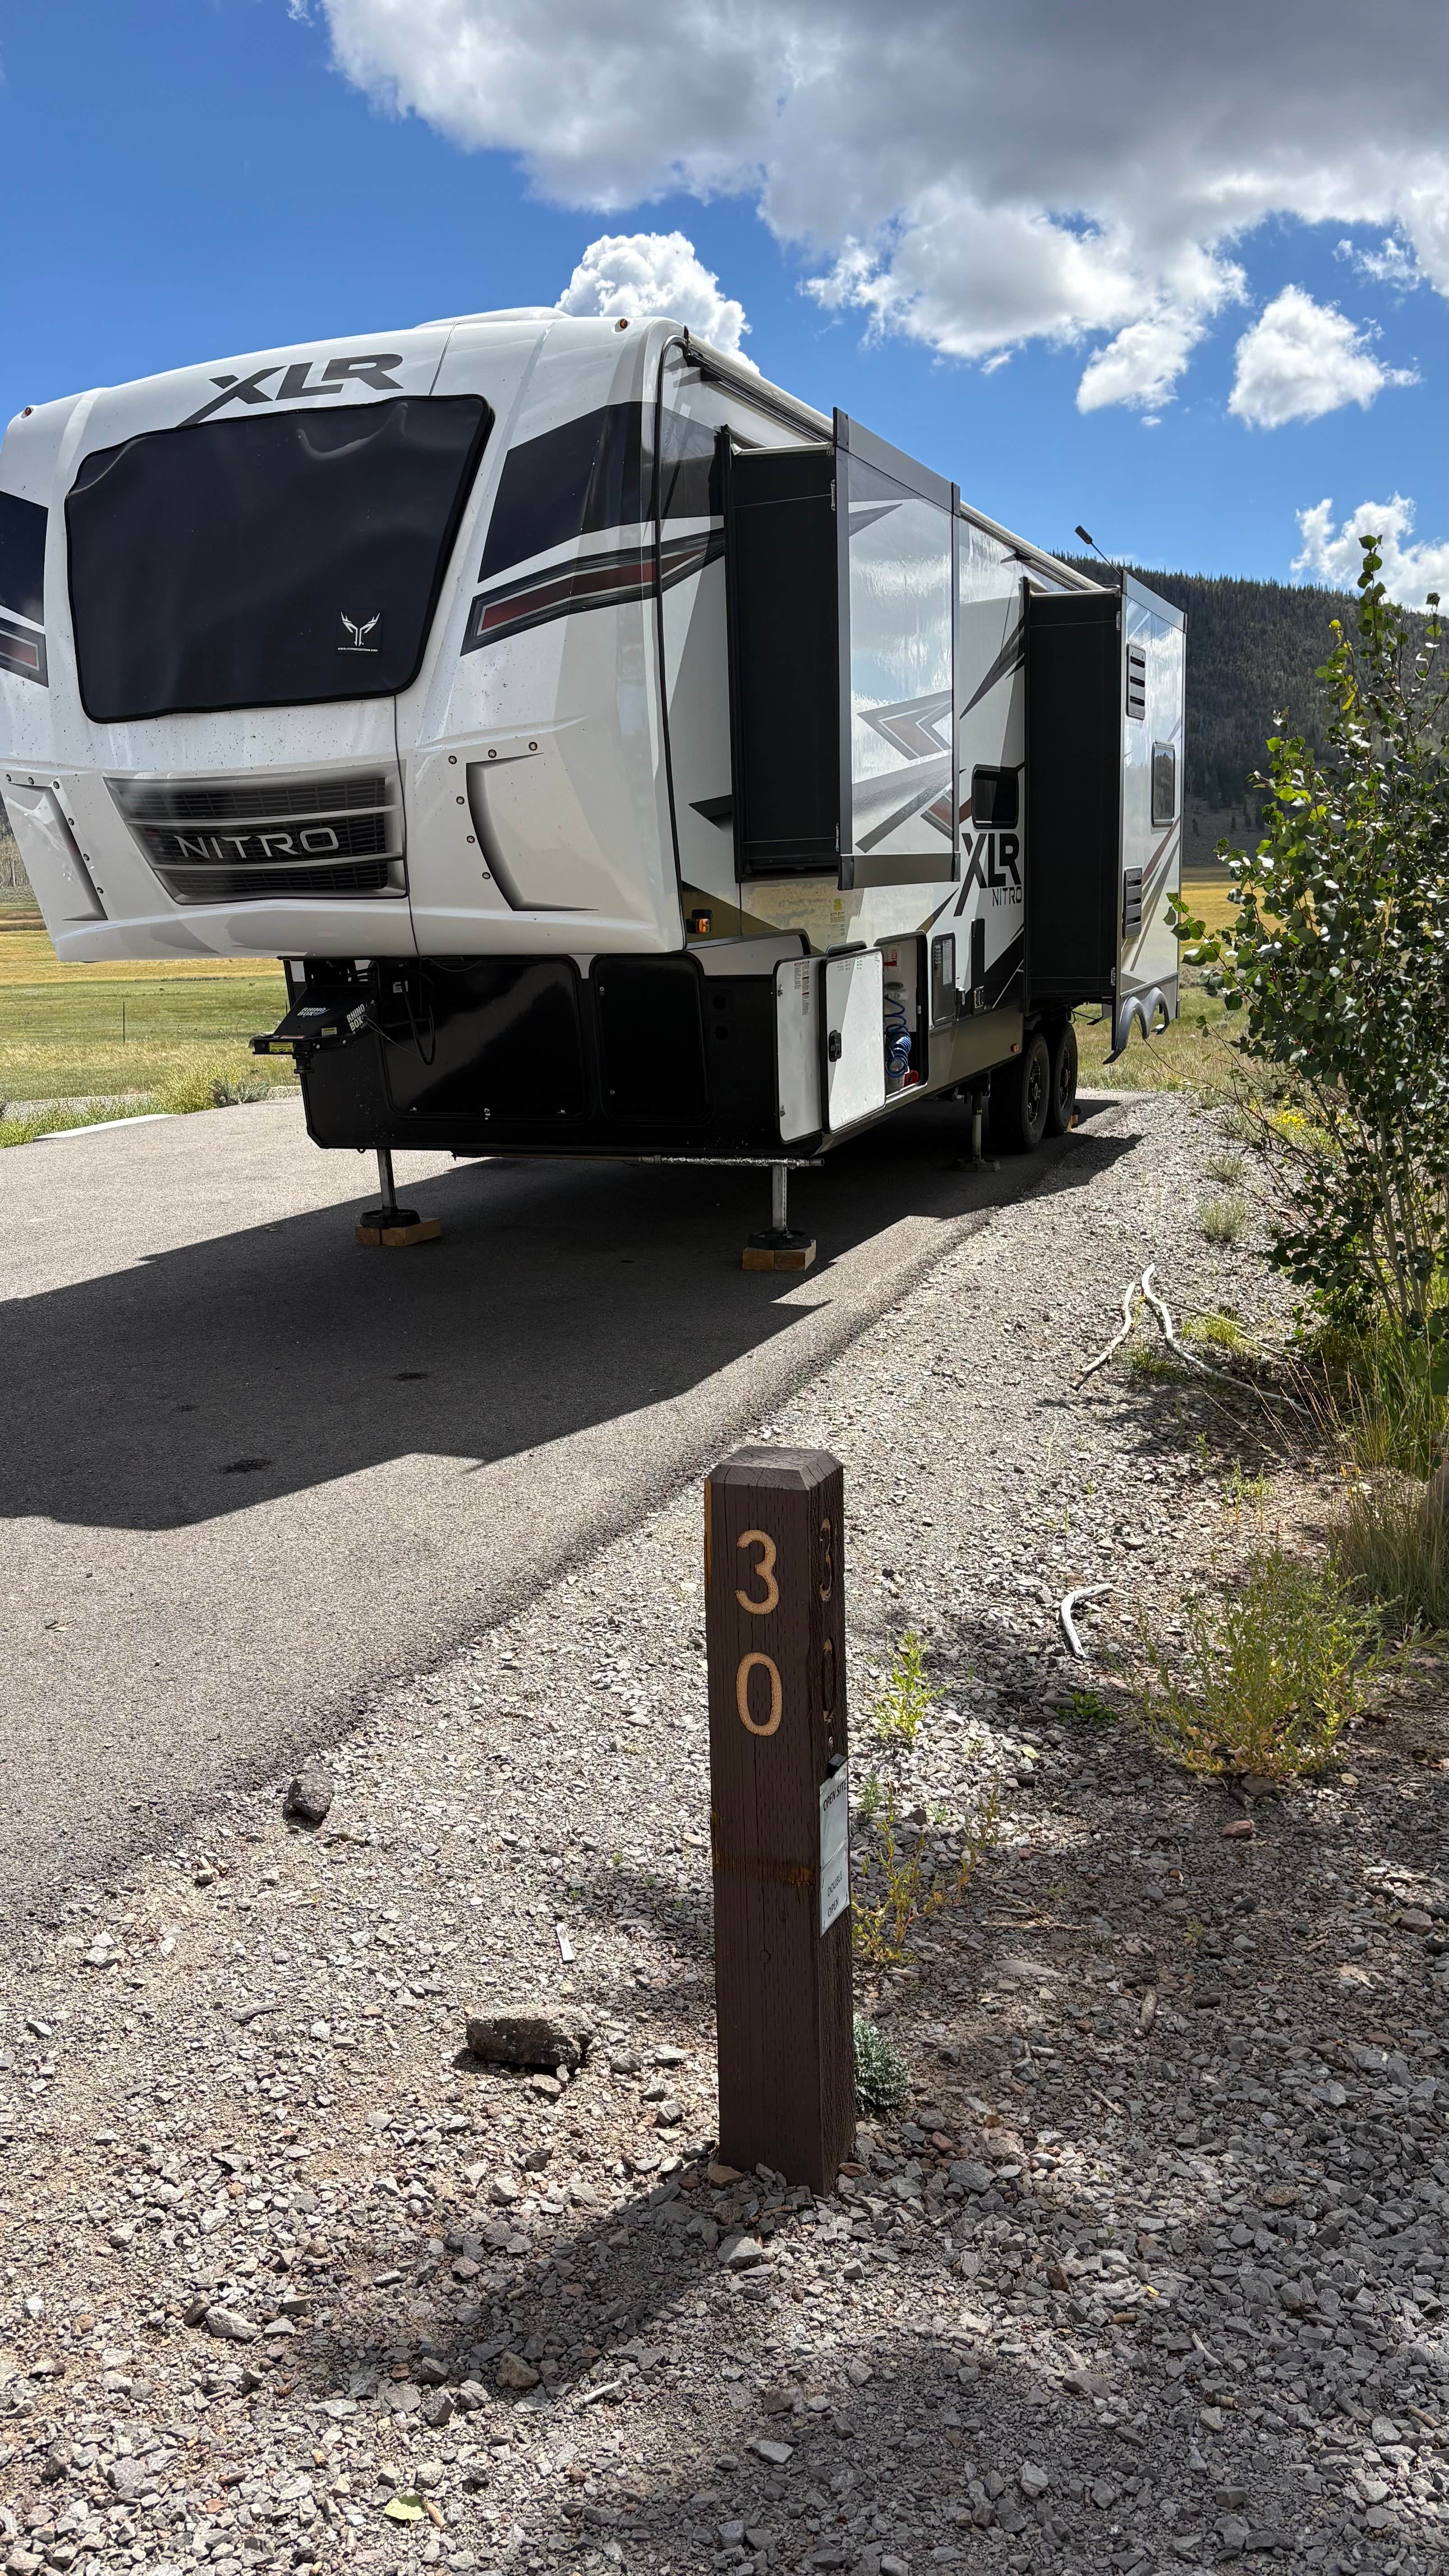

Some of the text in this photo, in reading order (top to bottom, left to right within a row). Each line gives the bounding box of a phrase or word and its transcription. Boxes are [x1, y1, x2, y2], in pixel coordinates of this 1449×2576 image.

[175, 354, 404, 428] XLR
[174, 827, 339, 859] NITRO
[953, 833, 1021, 917] XLR
[992, 886, 1022, 907] NITRO
[346, 1003, 365, 1023] RHINO
[349, 1016, 363, 1032] BOX
[823, 1778, 847, 1812] OPEN SITE
[827, 1870, 842, 1897] DOUBLE
[828, 1896, 839, 1917] OPEN
